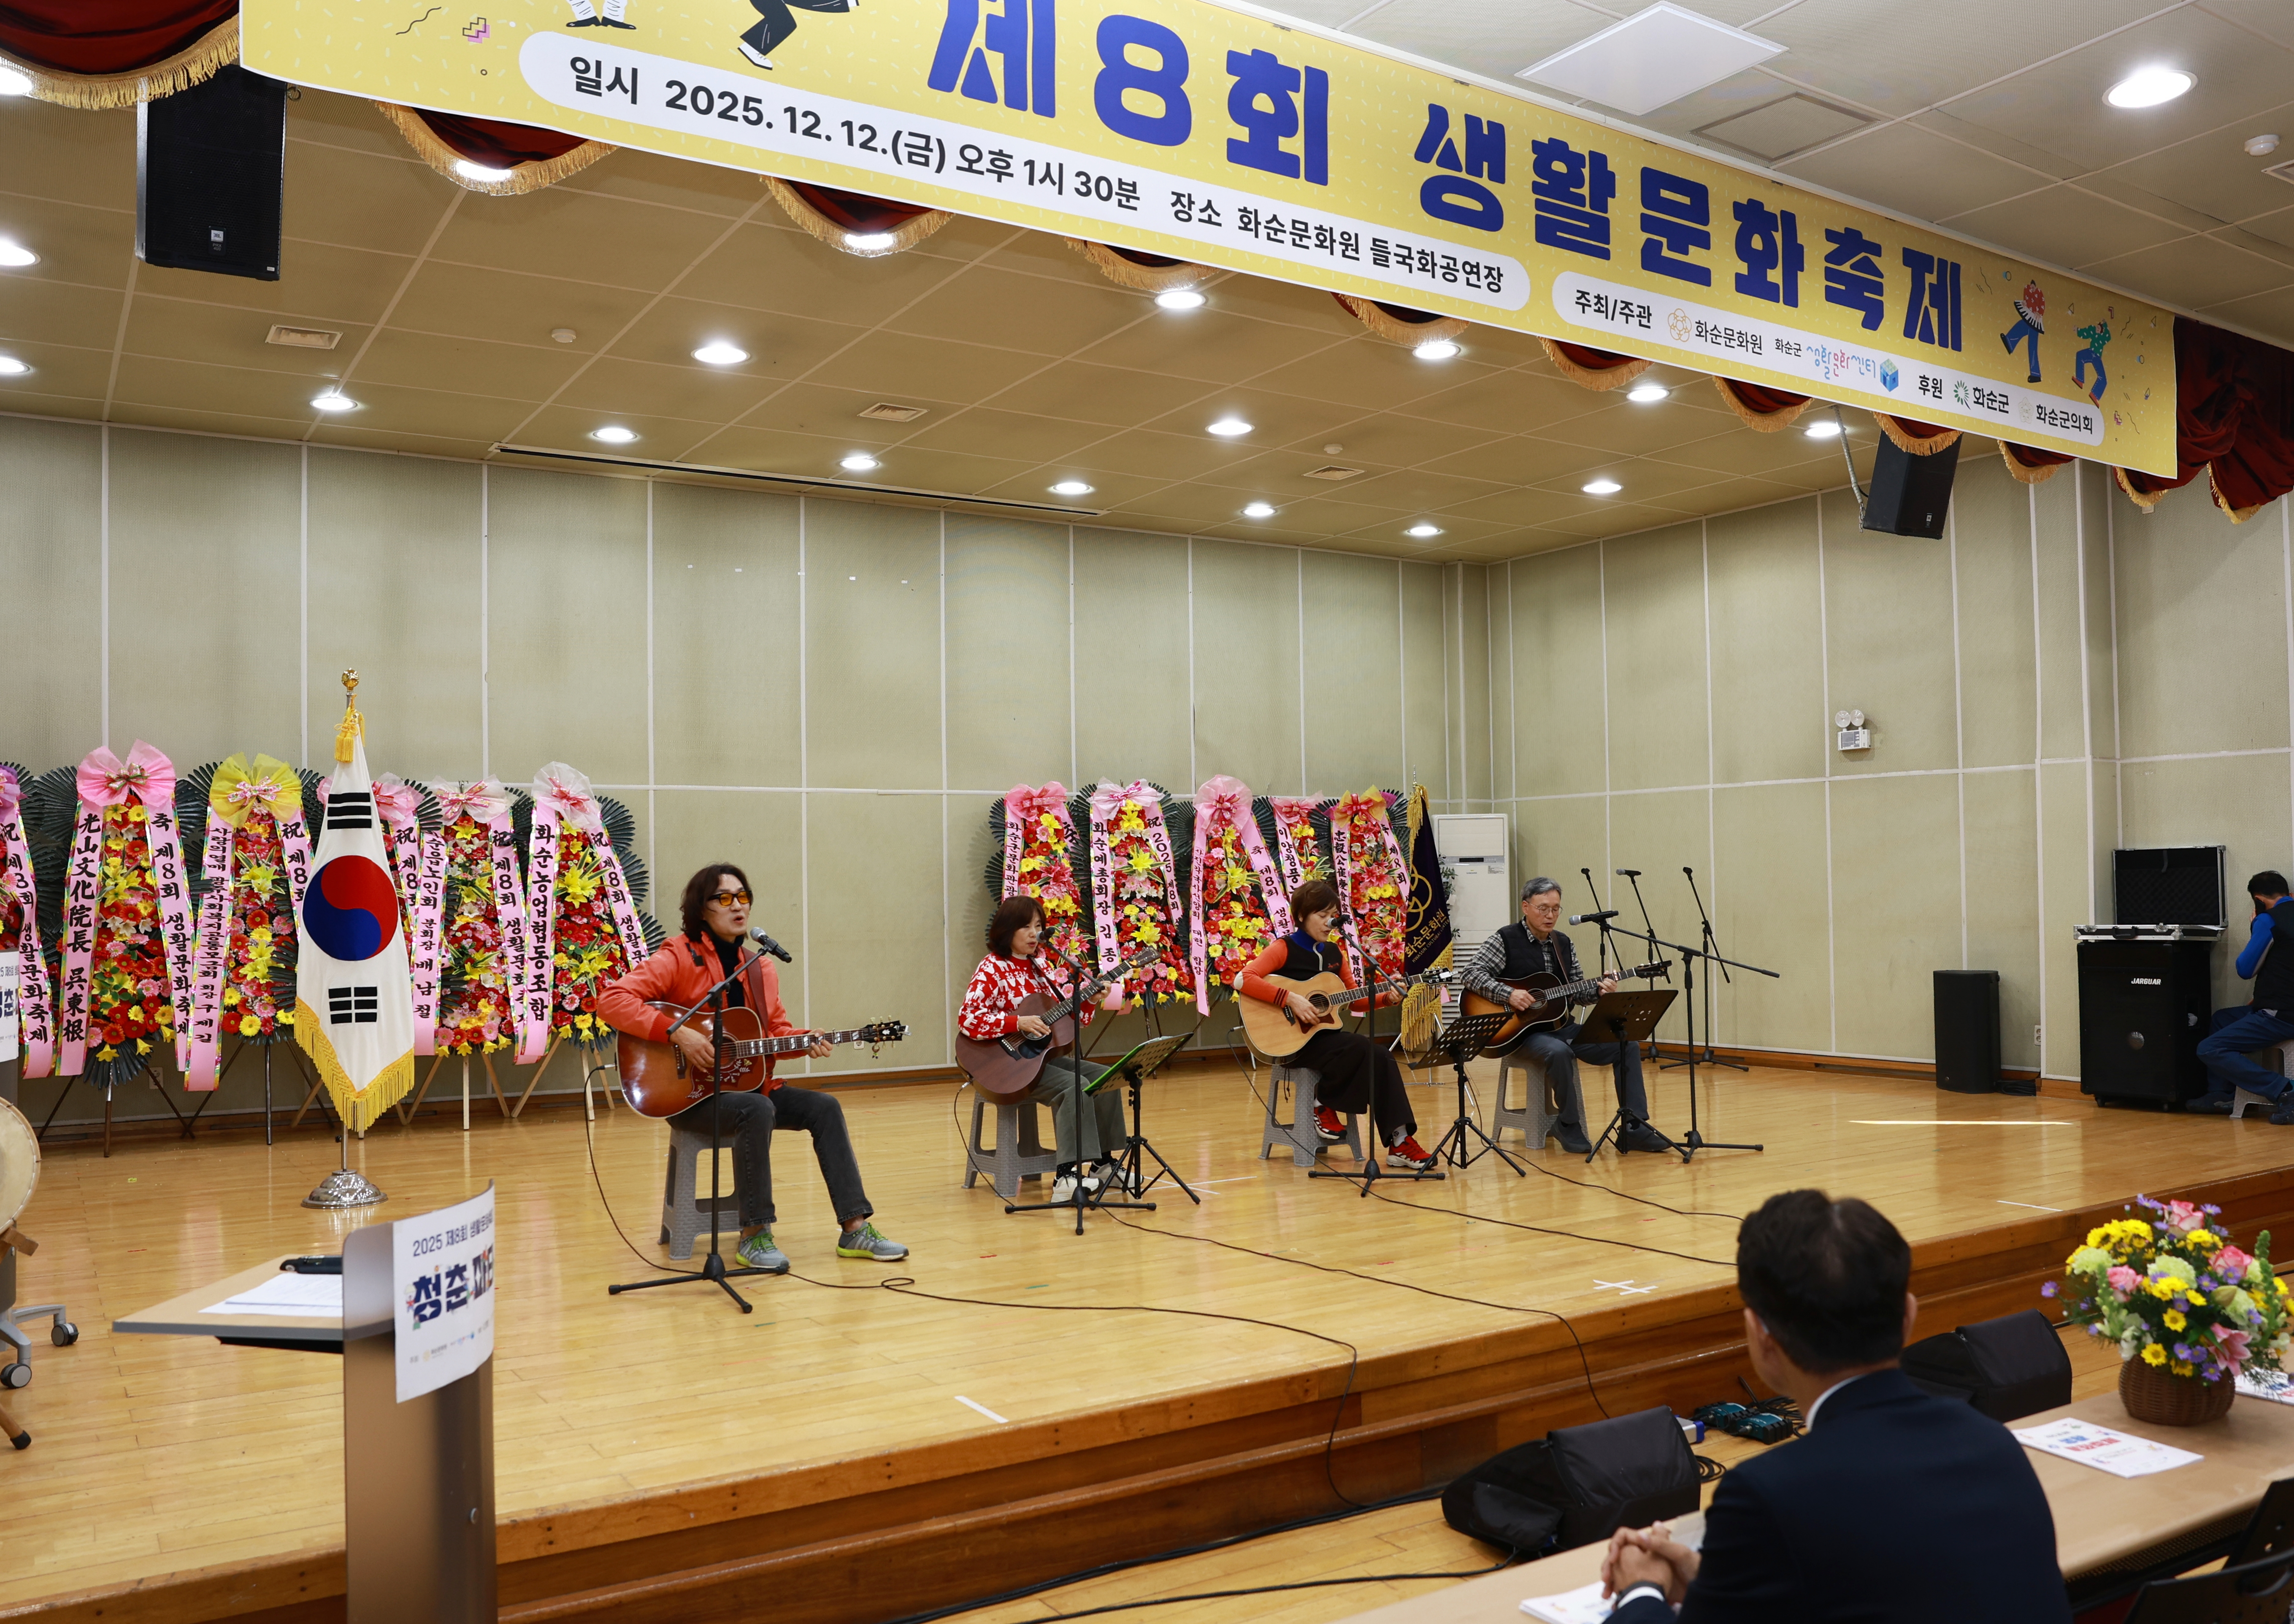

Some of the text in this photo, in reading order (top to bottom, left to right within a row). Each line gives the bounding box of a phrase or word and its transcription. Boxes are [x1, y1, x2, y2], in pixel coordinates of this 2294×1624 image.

[570, 56, 638, 105] 일시
[665, 80, 774, 129] 2025.
[783, 105, 832, 141] 12.
[956, 143, 1014, 183] 오후
[1023, 158, 1064, 196] 1시
[1074, 171, 1140, 211] 30분
[1170, 190, 1222, 227] 장소
[1237, 206, 1360, 262] 화순문화원
[1369, 236, 1504, 293] 들국화공연장
[1414, 103, 1962, 352] 생활문화축제
[1574, 289, 1653, 330] 주최/주관
[1694, 319, 1763, 355] 화순문화원
[1775, 338, 1802, 357] 화순군
[1918, 374, 1943, 400] 후원
[1972, 386, 2010, 414] 화순군
[2036, 403, 2093, 435] 화순군의회
[281, 821, 305, 840] 祝
[395, 827, 417, 844] 祝
[590, 831, 609, 847] 祝
[1146, 816, 1162, 828] 祝
[206, 827, 232, 872] 사랑의열매
[1004, 821, 1022, 897] 화순군문화관광
[1093, 821, 1112, 916] 화순예총회장
[1152, 833, 1179, 911] 2025 제8회
[1250, 845, 1264, 855] 축
[1258, 865, 1279, 897] 제8회
[1381, 824, 1407, 884] 축 제8회
[67, 813, 102, 954] 光山文化院長
[495, 857, 517, 908] 제8회
[602, 856, 626, 905] 제8회
[150, 812, 192, 1035] 축 제8회 생활문화축제
[419, 918, 437, 951] 분회장
[528, 824, 555, 1021] 화순농업협동조합
[1405, 908, 1447, 957] 화순문화원
[1412, 947, 1427, 963] HWASUN
[1426, 931, 1441, 948] CULTURAL
[19, 922, 49, 1044] 생활문화축제
[1193, 956, 1204, 975] 합장
[199, 984, 218, 999] 회장
[413, 1233, 442, 1257] 2025
[445, 1225, 468, 1247] 제8회
[412, 1263, 467, 1322] 청춘
